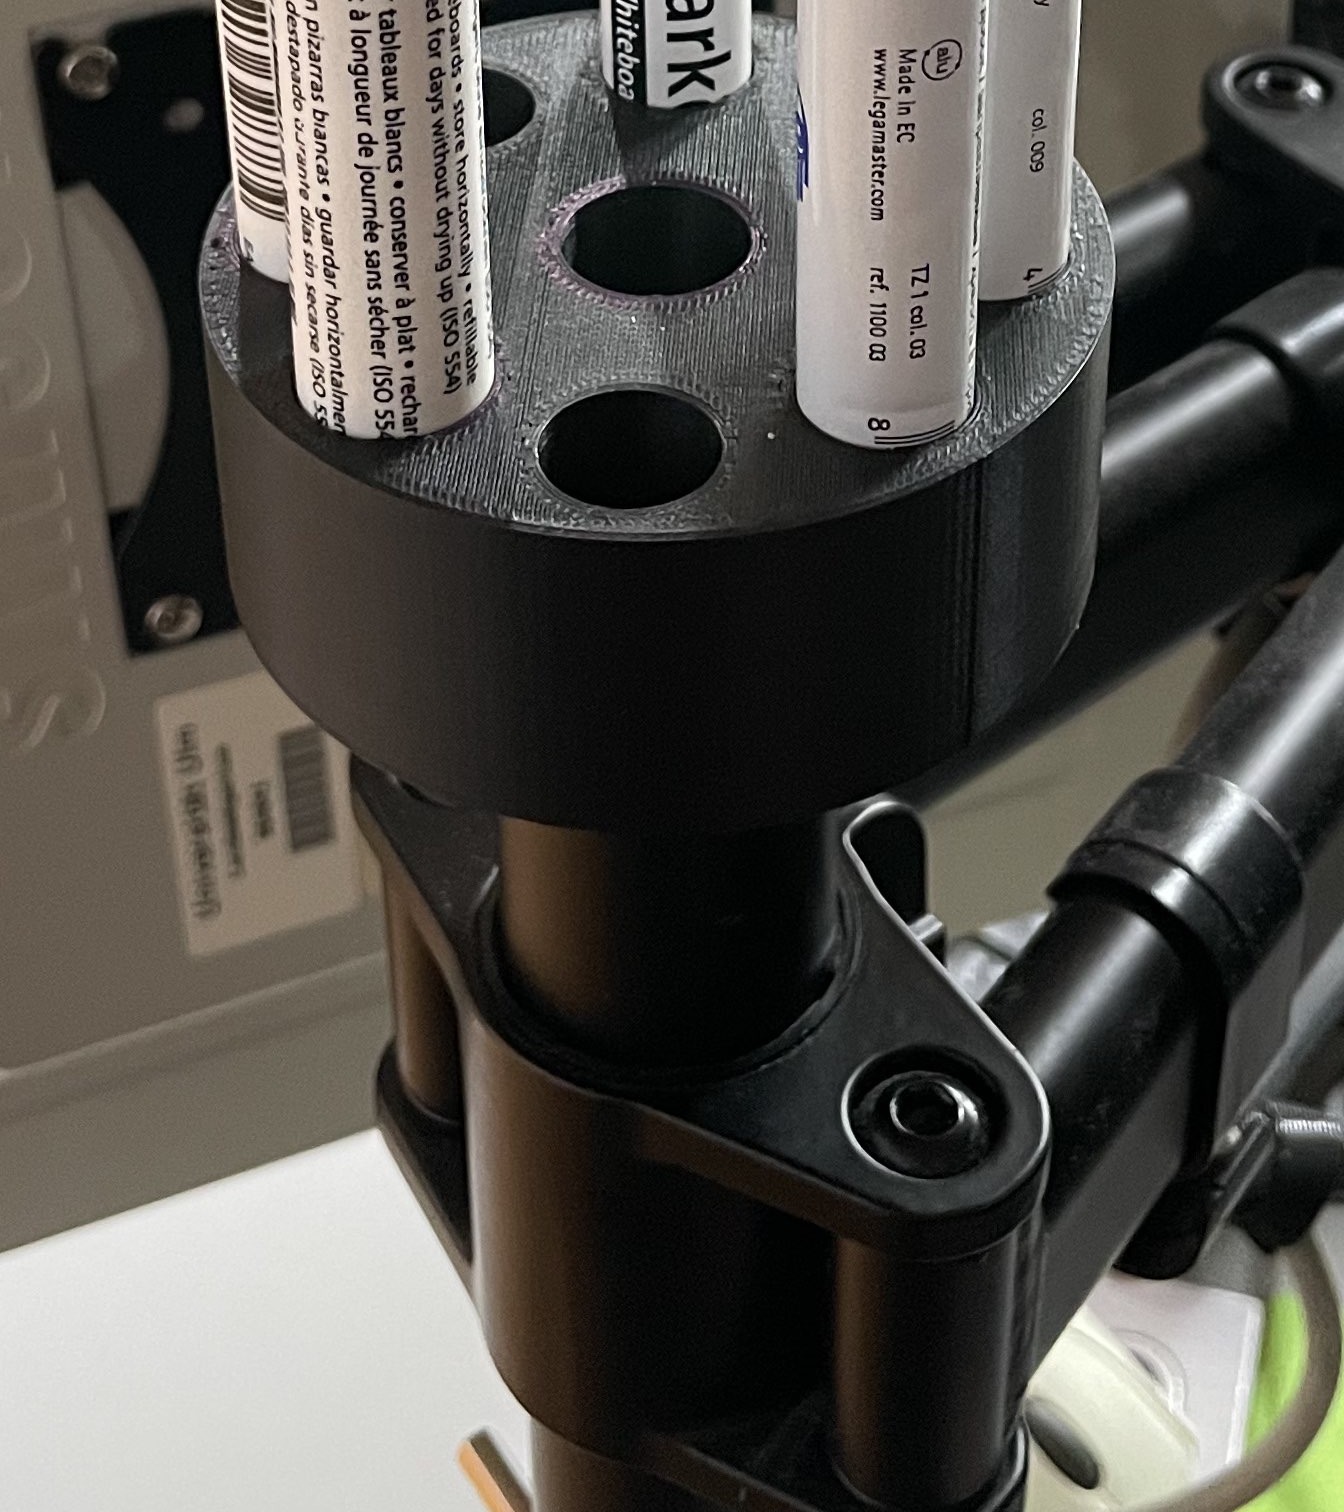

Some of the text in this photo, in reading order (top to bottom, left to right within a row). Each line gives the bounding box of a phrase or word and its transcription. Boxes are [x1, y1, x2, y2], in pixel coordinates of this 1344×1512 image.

[350, 9, 372, 21] à
[283, 0, 305, 112] destapado
[378, 9, 401, 101] tableaux
[426, 28, 445, 59] for
[934, 46, 953, 75] alu
[348, 30, 371, 125] longueur
[425, 67, 447, 114] days
[897, 48, 916, 143] Made in EC
[357, 133, 378, 158] de
[384, 110, 406, 174] blancs
[453, 99, 468, 153] store
[869, 49, 890, 221] www.legamaster.com
[1030, 108, 1046, 173] col. 009
[302, 17, 328, 101] pizarras
[316, 207, 339, 289] guardar
[431, 118, 453, 203] without
[299, 206, 315, 246] días
[354, 164, 382, 243] journée
[455, 156, 473, 278] horizontally
[302, 252, 318, 281] sin
[389, 197, 412, 290] conserver
[433, 210, 454, 273] drying
[364, 250, 384, 290] sans
[437, 278, 456, 303] up
[911, 264, 929, 287] TZ
[305, 284, 321, 350] secarse
[369, 297, 389, 358] sécher
[396, 298, 415, 309] à
[439, 309, 461, 347] (ISO
[869, 267, 888, 362] ref. 1100 03
[909, 305, 927, 336] col.
[393, 316, 417, 354] plat
[463, 300, 478, 384] refillable
[909, 339, 925, 359] 03
[308, 358, 325, 399] (ISO
[369, 366, 393, 402] (ISO
[443, 352, 462, 395] 554)
[399, 377, 421, 438] rechar
[868, 417, 890, 431] 8
